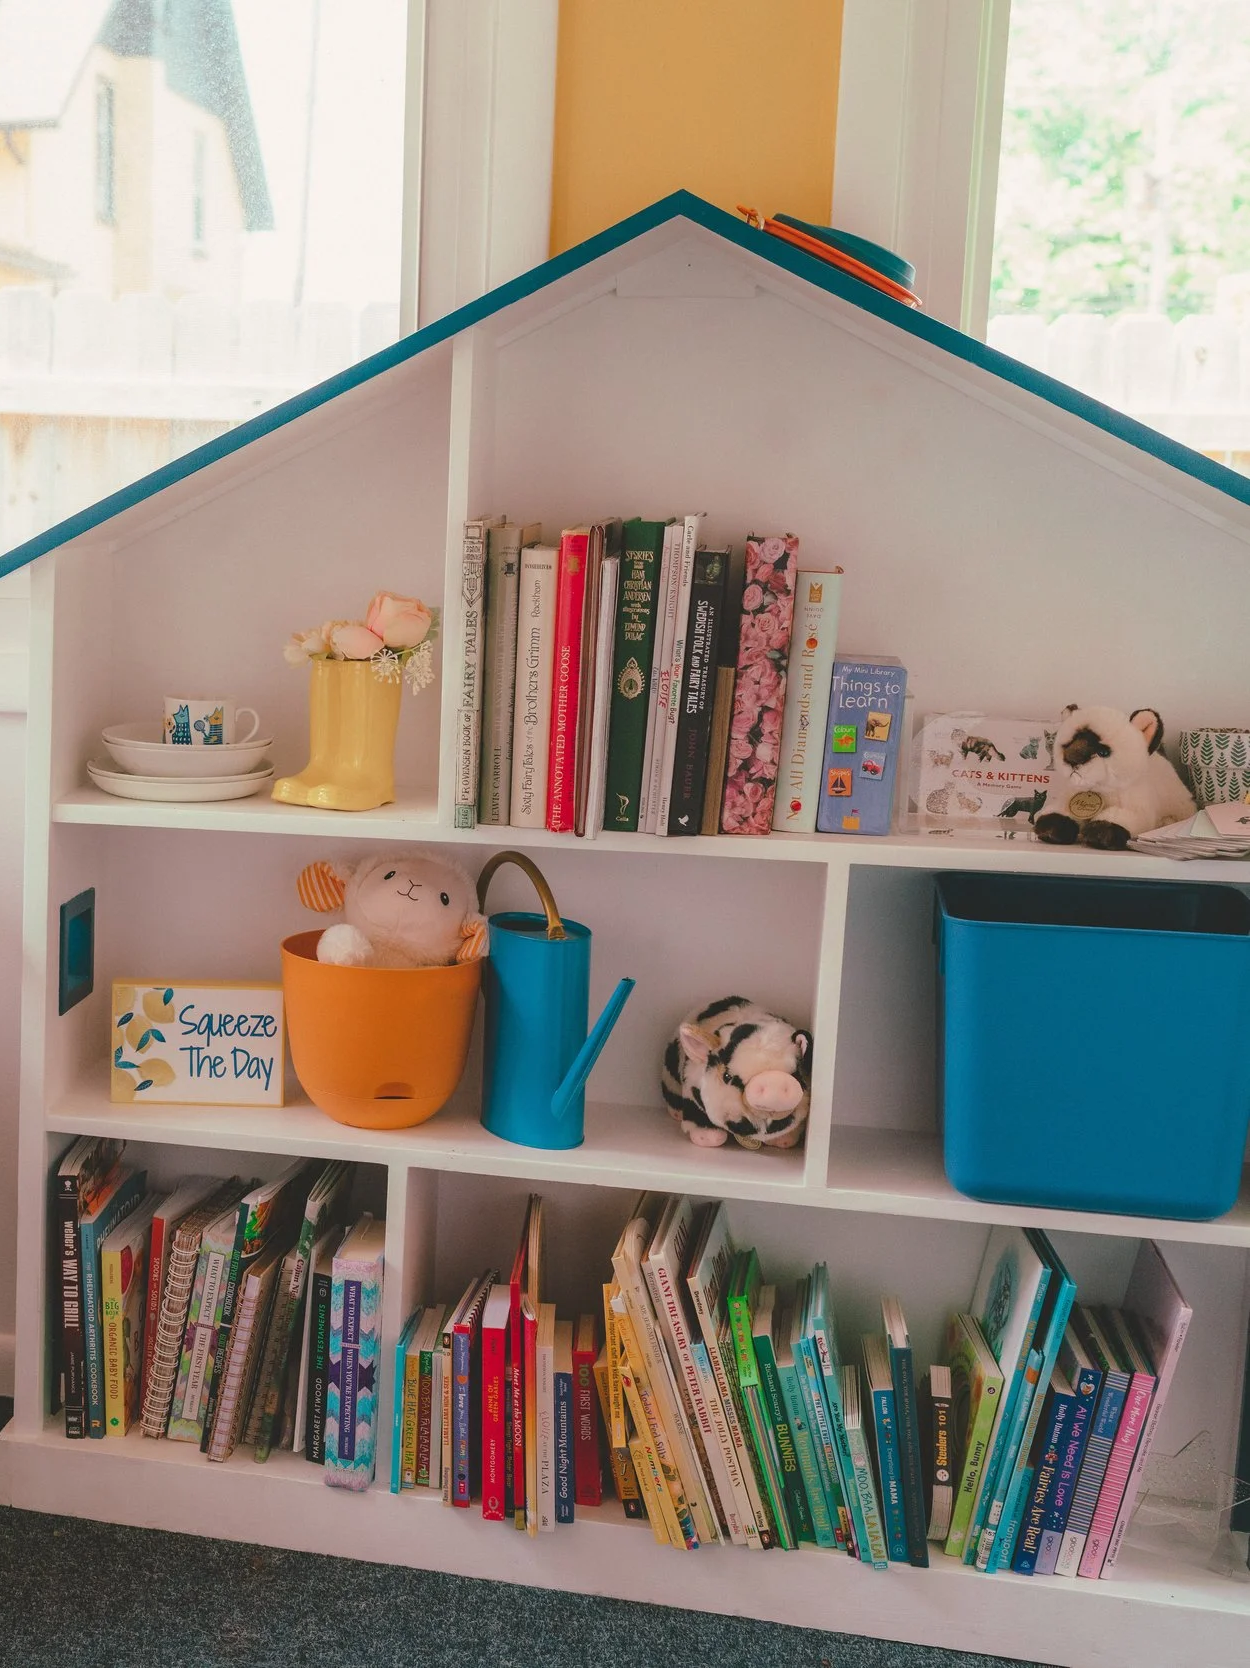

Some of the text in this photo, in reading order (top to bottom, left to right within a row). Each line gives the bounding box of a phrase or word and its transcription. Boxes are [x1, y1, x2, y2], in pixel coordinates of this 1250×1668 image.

[686, 525, 694, 545] Carle
[682, 561, 692, 587] Friends
[623, 591, 651, 602] ANDERSEN
[464, 610, 478, 658] TALES
[686, 600, 708, 714] SWEDISH FOLK AND FAIRY TALES
[700, 618, 713, 700] ILLUSTRATED TREASURY
[842, 666, 896, 677] My Mini Library
[463, 660, 476, 708] FAIRY
[521, 580, 542, 815] Sixty Fairy Tales Brothers Grimm Rackham
[658, 670, 670, 709] ELOISE
[668, 639, 684, 724] What's Your Favorite Bug?
[832, 676, 900, 696] Things to
[463, 724, 472, 746] BOOK
[552, 646, 570, 827] THE ANNOTATED MOTHER GOOSE
[686, 728, 698, 760] JOHN
[790, 663, 815, 794] All and
[834, 726, 856, 734] Colours
[462, 748, 472, 801] PROVENSEN
[492, 745, 502, 822] LEWIS CARROLL
[952, 768, 1050, 784] CATS & KITTENS
[982, 782, 1004, 790] Memory
[179, 1004, 278, 1047] Squeeze
[179, 1046, 274, 1091] The Day
[63, 1221, 78, 1328] weber's WAY TO GRILL
[209, 1282, 216, 1290] TO
[210, 1259, 220, 1280] WHAT
[224, 1261, 240, 1316] FRYER COOKBOOK
[294, 1259, 304, 1283] Cajun
[647, 1271, 660, 1302] Bernstein
[105, 1302, 119, 1310] BIG
[204, 1291, 214, 1320] EXPECT
[348, 1307, 355, 1315] TO
[694, 1291, 704, 1314] Dewdney
[1038, 1284, 1046, 1302] Pfister
[86, 1273, 99, 1406] RHEUMATOID ARTHRITIS COOKBOOK
[316, 1304, 326, 1370] THE TESTAMENTS
[658, 1268, 712, 1434] GIANT TREASURY PETER RABBIT
[108, 1322, 118, 1400] ORGANIC BABY FOOD
[191, 1332, 206, 1390] THE FIRST YEAR
[214, 1348, 224, 1374] RECIPES
[346, 1348, 354, 1369] WHEN
[488, 1384, 494, 1393] OF
[514, 1387, 520, 1399] Me
[578, 1363, 591, 1441] 100 FIRST WORDS
[710, 1346, 742, 1449] LLAMA LLAMA MISSES MAMA
[764, 1363, 782, 1422] Richard Scarry's
[312, 1378, 322, 1458] MARGARET ATWOOD
[344, 1395, 352, 1432] EXPECTING
[404, 1378, 417, 1467] BLUE GREEN HAT
[513, 1408, 522, 1419] the
[514, 1419, 522, 1447] MOON
[558, 1402, 568, 1449] Mountains
[641, 1390, 666, 1460] Today Feel Silly
[814, 1398, 826, 1427] THE LITTLE
[1052, 1404, 1068, 1444] Holly Hatam
[1122, 1390, 1146, 1443] One More Hug
[710, 1399, 740, 1488] THE JOLLY POSTMAN
[936, 1410, 947, 1466] Steelers 101
[1054, 1405, 1088, 1507] All We Need Is Love
[542, 1460, 550, 1494] PLAZA
[558, 1450, 569, 1474] Night
[645, 1446, 662, 1492] Numbers
[964, 1440, 984, 1493] Hello, Bunny
[560, 1476, 568, 1498] Good
[889, 1480, 898, 1505] MAMA
[756, 1510, 764, 1528] Viking
[1022, 1466, 1056, 1554] Fairies Are Real!
[1000, 1519, 1018, 1563] transport
